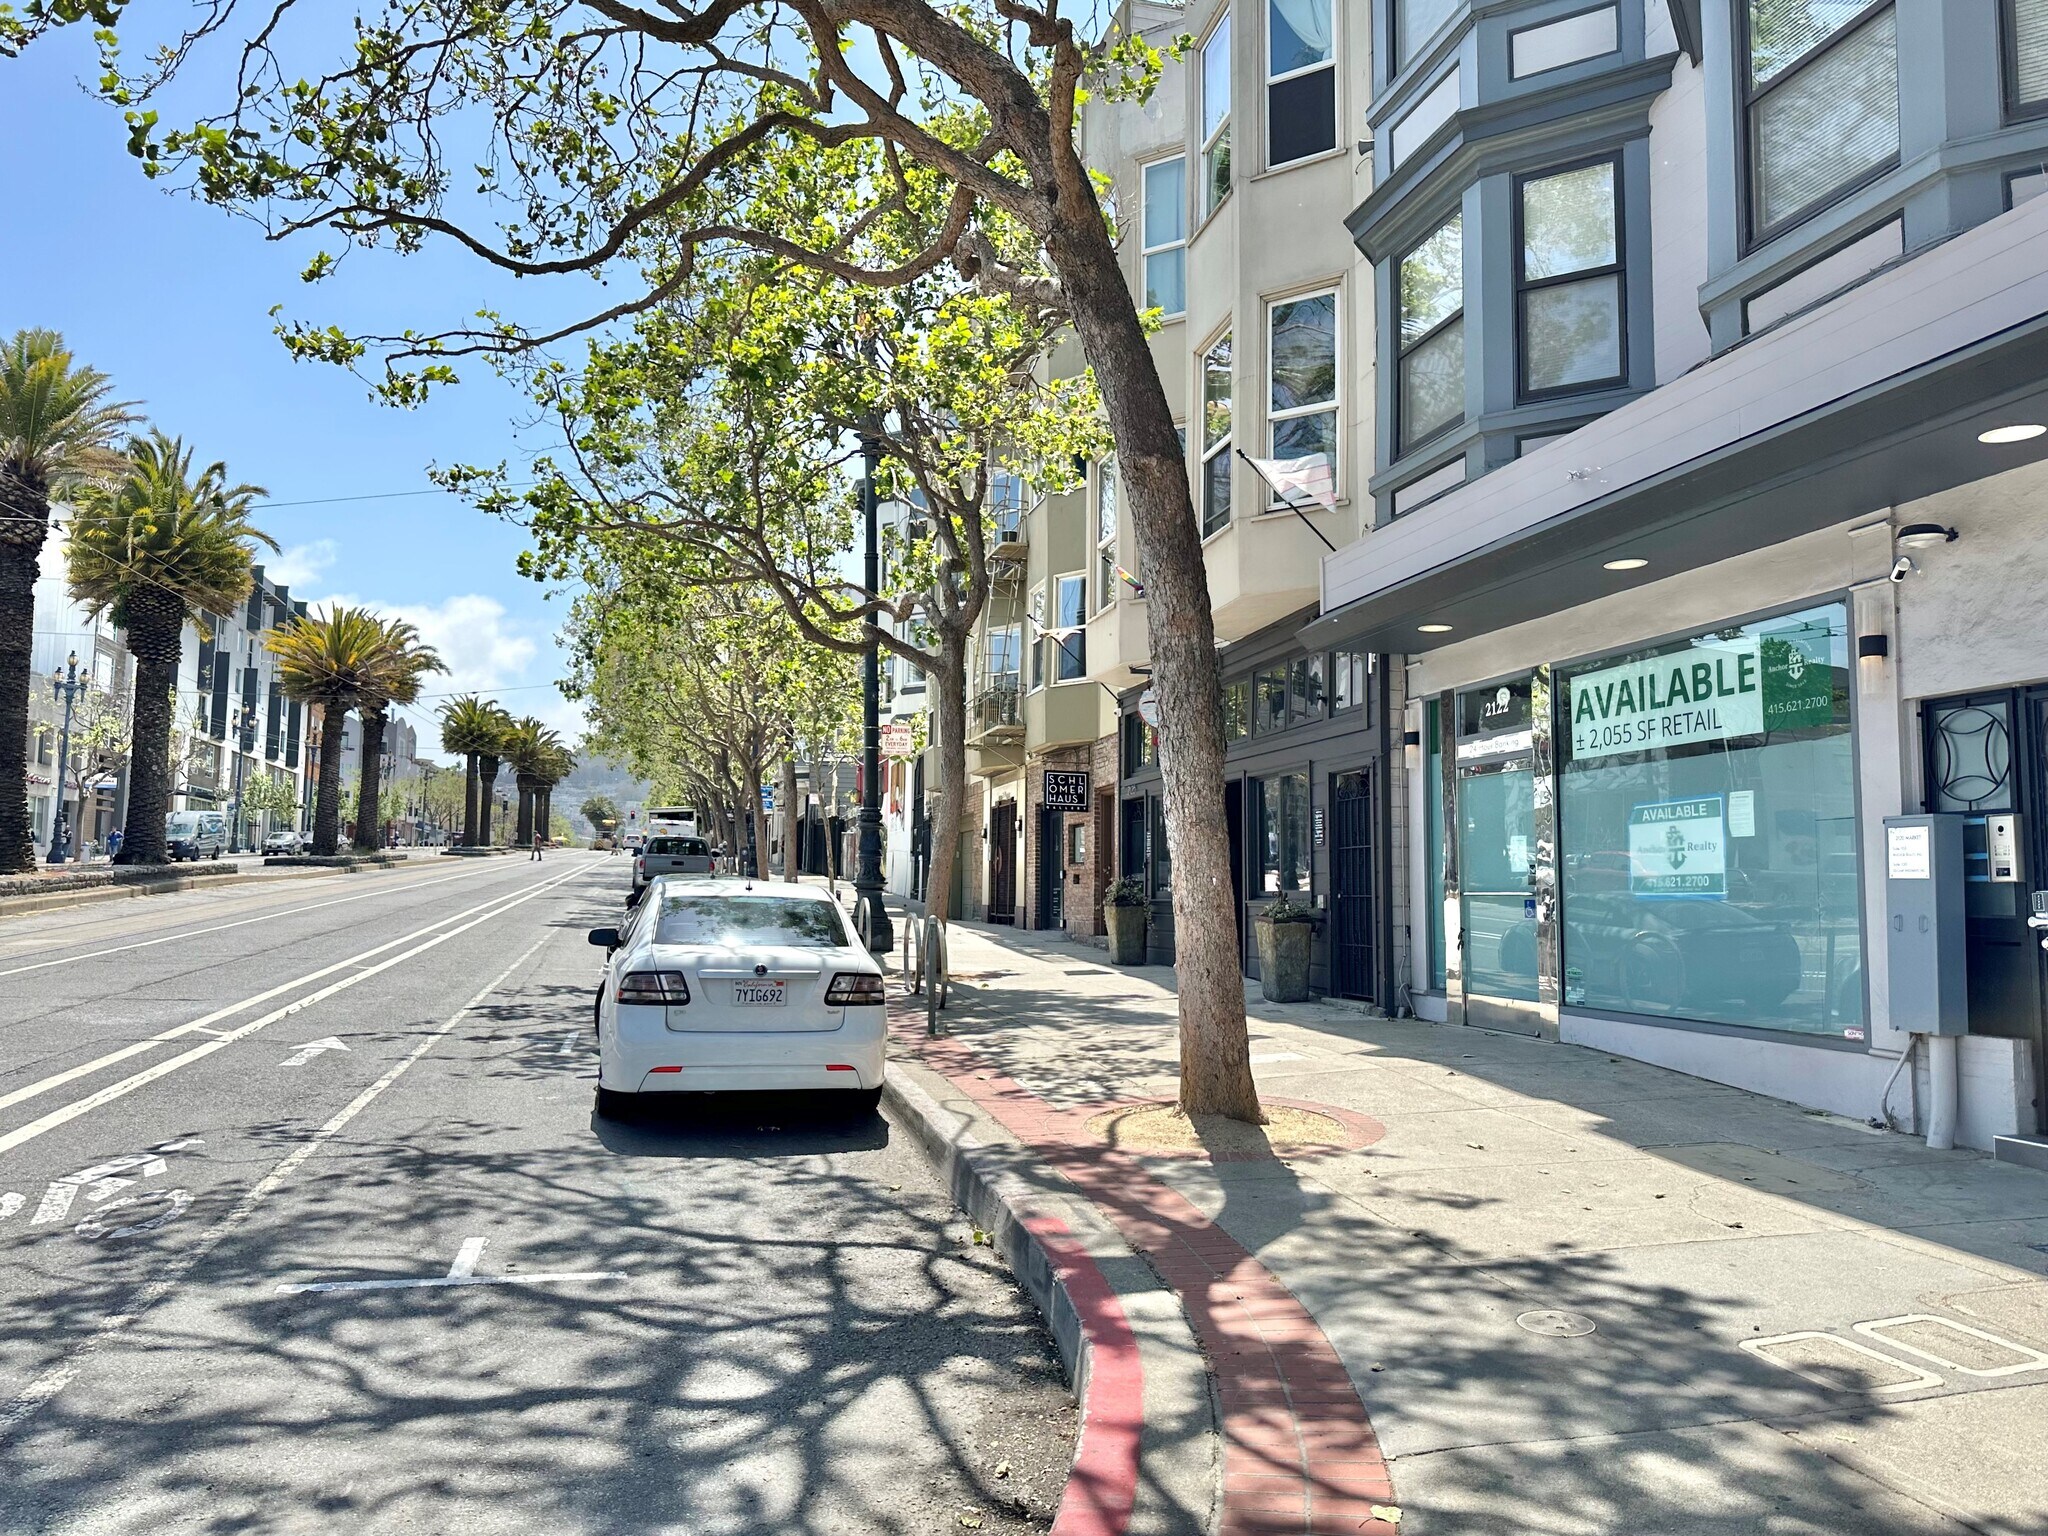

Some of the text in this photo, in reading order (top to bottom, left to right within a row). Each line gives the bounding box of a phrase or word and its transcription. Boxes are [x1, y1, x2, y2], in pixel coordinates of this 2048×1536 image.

[1768, 656, 1825, 673] Anchor Realty
[1575, 651, 1756, 724] AVAILABLE
[1485, 701, 1509, 717] 2122
[1768, 695, 1828, 715] 415.621.2700
[882, 726, 891, 734] NO
[1589, 723, 1632, 751] 2,055
[1637, 718, 1656, 741] SF
[1662, 708, 1722, 737] RETAIL
[1049, 775, 1084, 785] SCHL
[1049, 784, 1084, 794] OMER
[1049, 794, 1078, 804] HAUS
[1642, 804, 1707, 821] AVAILABLE
[1687, 841, 1717, 852] Realty
[736, 988, 783, 1002] 7YIG692
